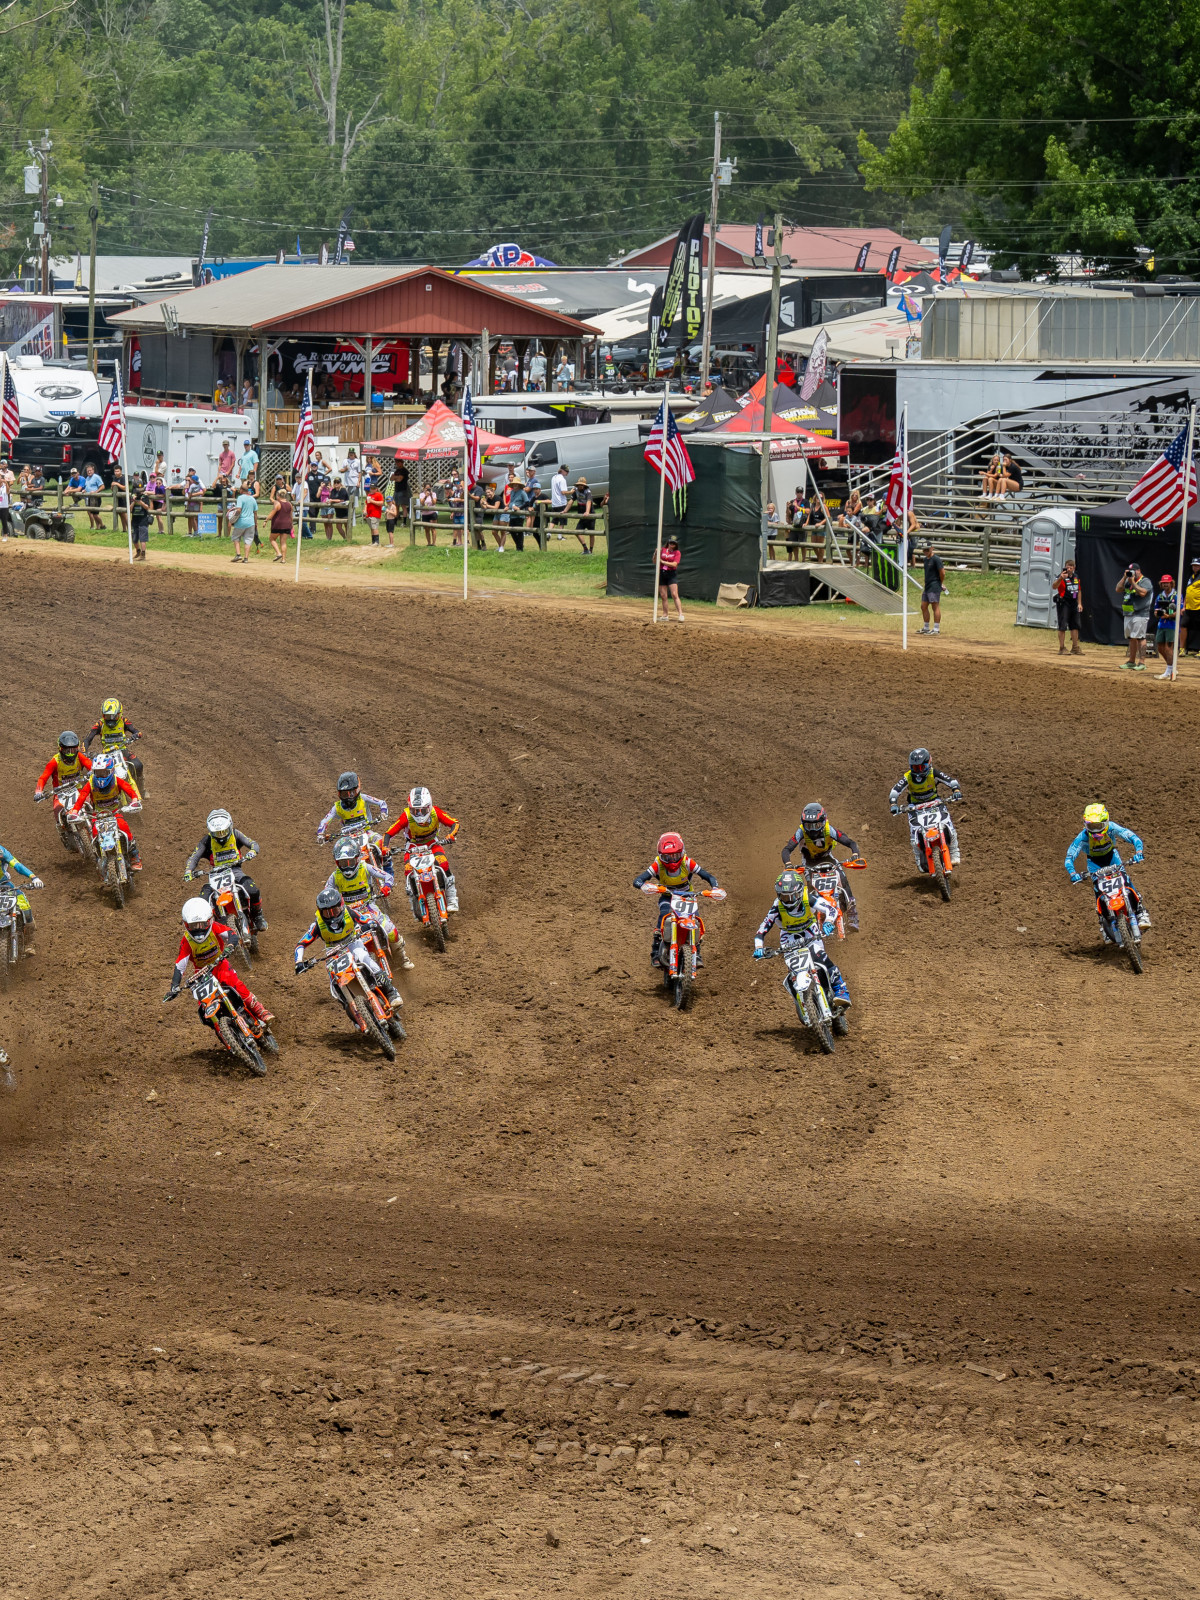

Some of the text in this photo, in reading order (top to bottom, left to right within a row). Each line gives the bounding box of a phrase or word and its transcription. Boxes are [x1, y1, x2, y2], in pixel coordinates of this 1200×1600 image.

[686, 238, 701, 340] PHOTOS
[1126, 529, 1159, 537] ENERGY
[922, 813, 938, 827] 12
[414, 856, 431, 868] 74
[213, 874, 232, 888] 73
[815, 876, 837, 890] 65
[1101, 876, 1124, 894] 54
[675, 900, 695, 914] 91
[331, 953, 351, 973] 13
[790, 953, 809, 970] 27
[196, 978, 215, 1000] 67
